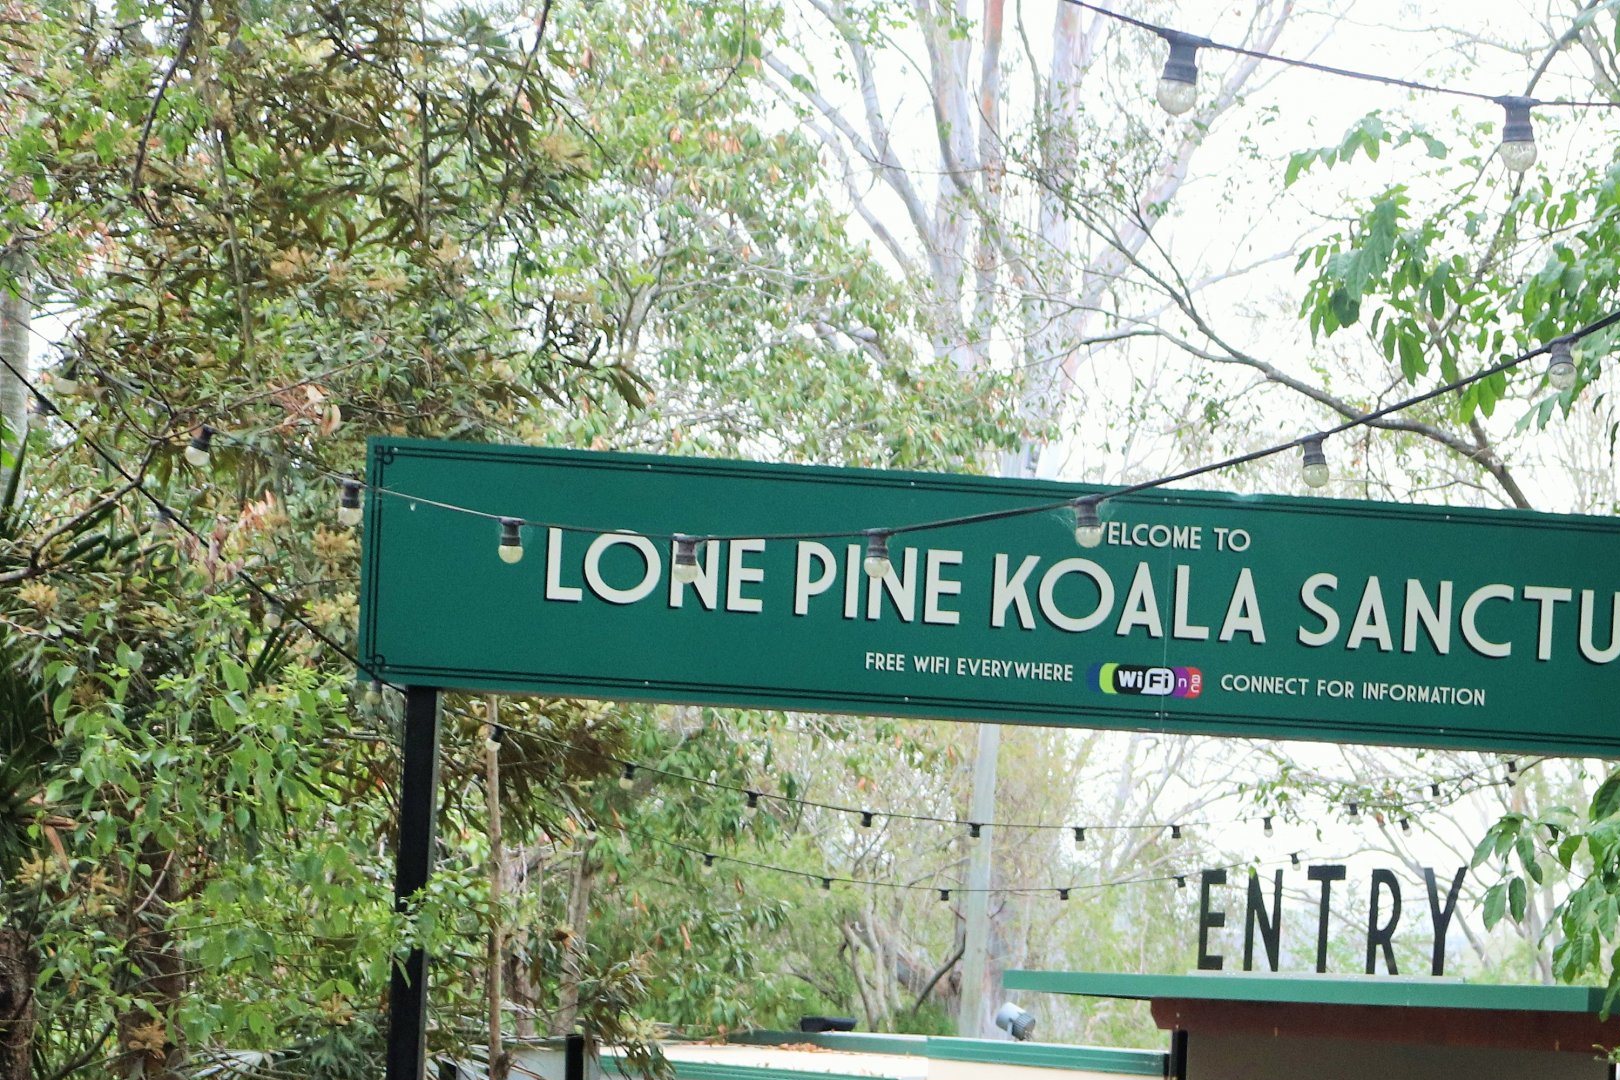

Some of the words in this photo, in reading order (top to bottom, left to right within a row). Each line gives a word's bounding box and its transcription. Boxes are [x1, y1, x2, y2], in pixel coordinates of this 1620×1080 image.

[1213, 527, 1251, 552] TO
[546, 527, 766, 612] LONE
[794, 540, 964, 626] PINE
[991, 553, 1267, 644] KOALA
[865, 652, 906, 672] FREE
[913, 655, 950, 675] WIFI
[956, 657, 1074, 682] EVERYWHERE
[1220, 673, 1310, 696] CONNECT
[1316, 679, 1355, 699] FOR
[1362, 682, 1486, 706] INFORMATION
[1197, 865, 1468, 976] ENTRY
